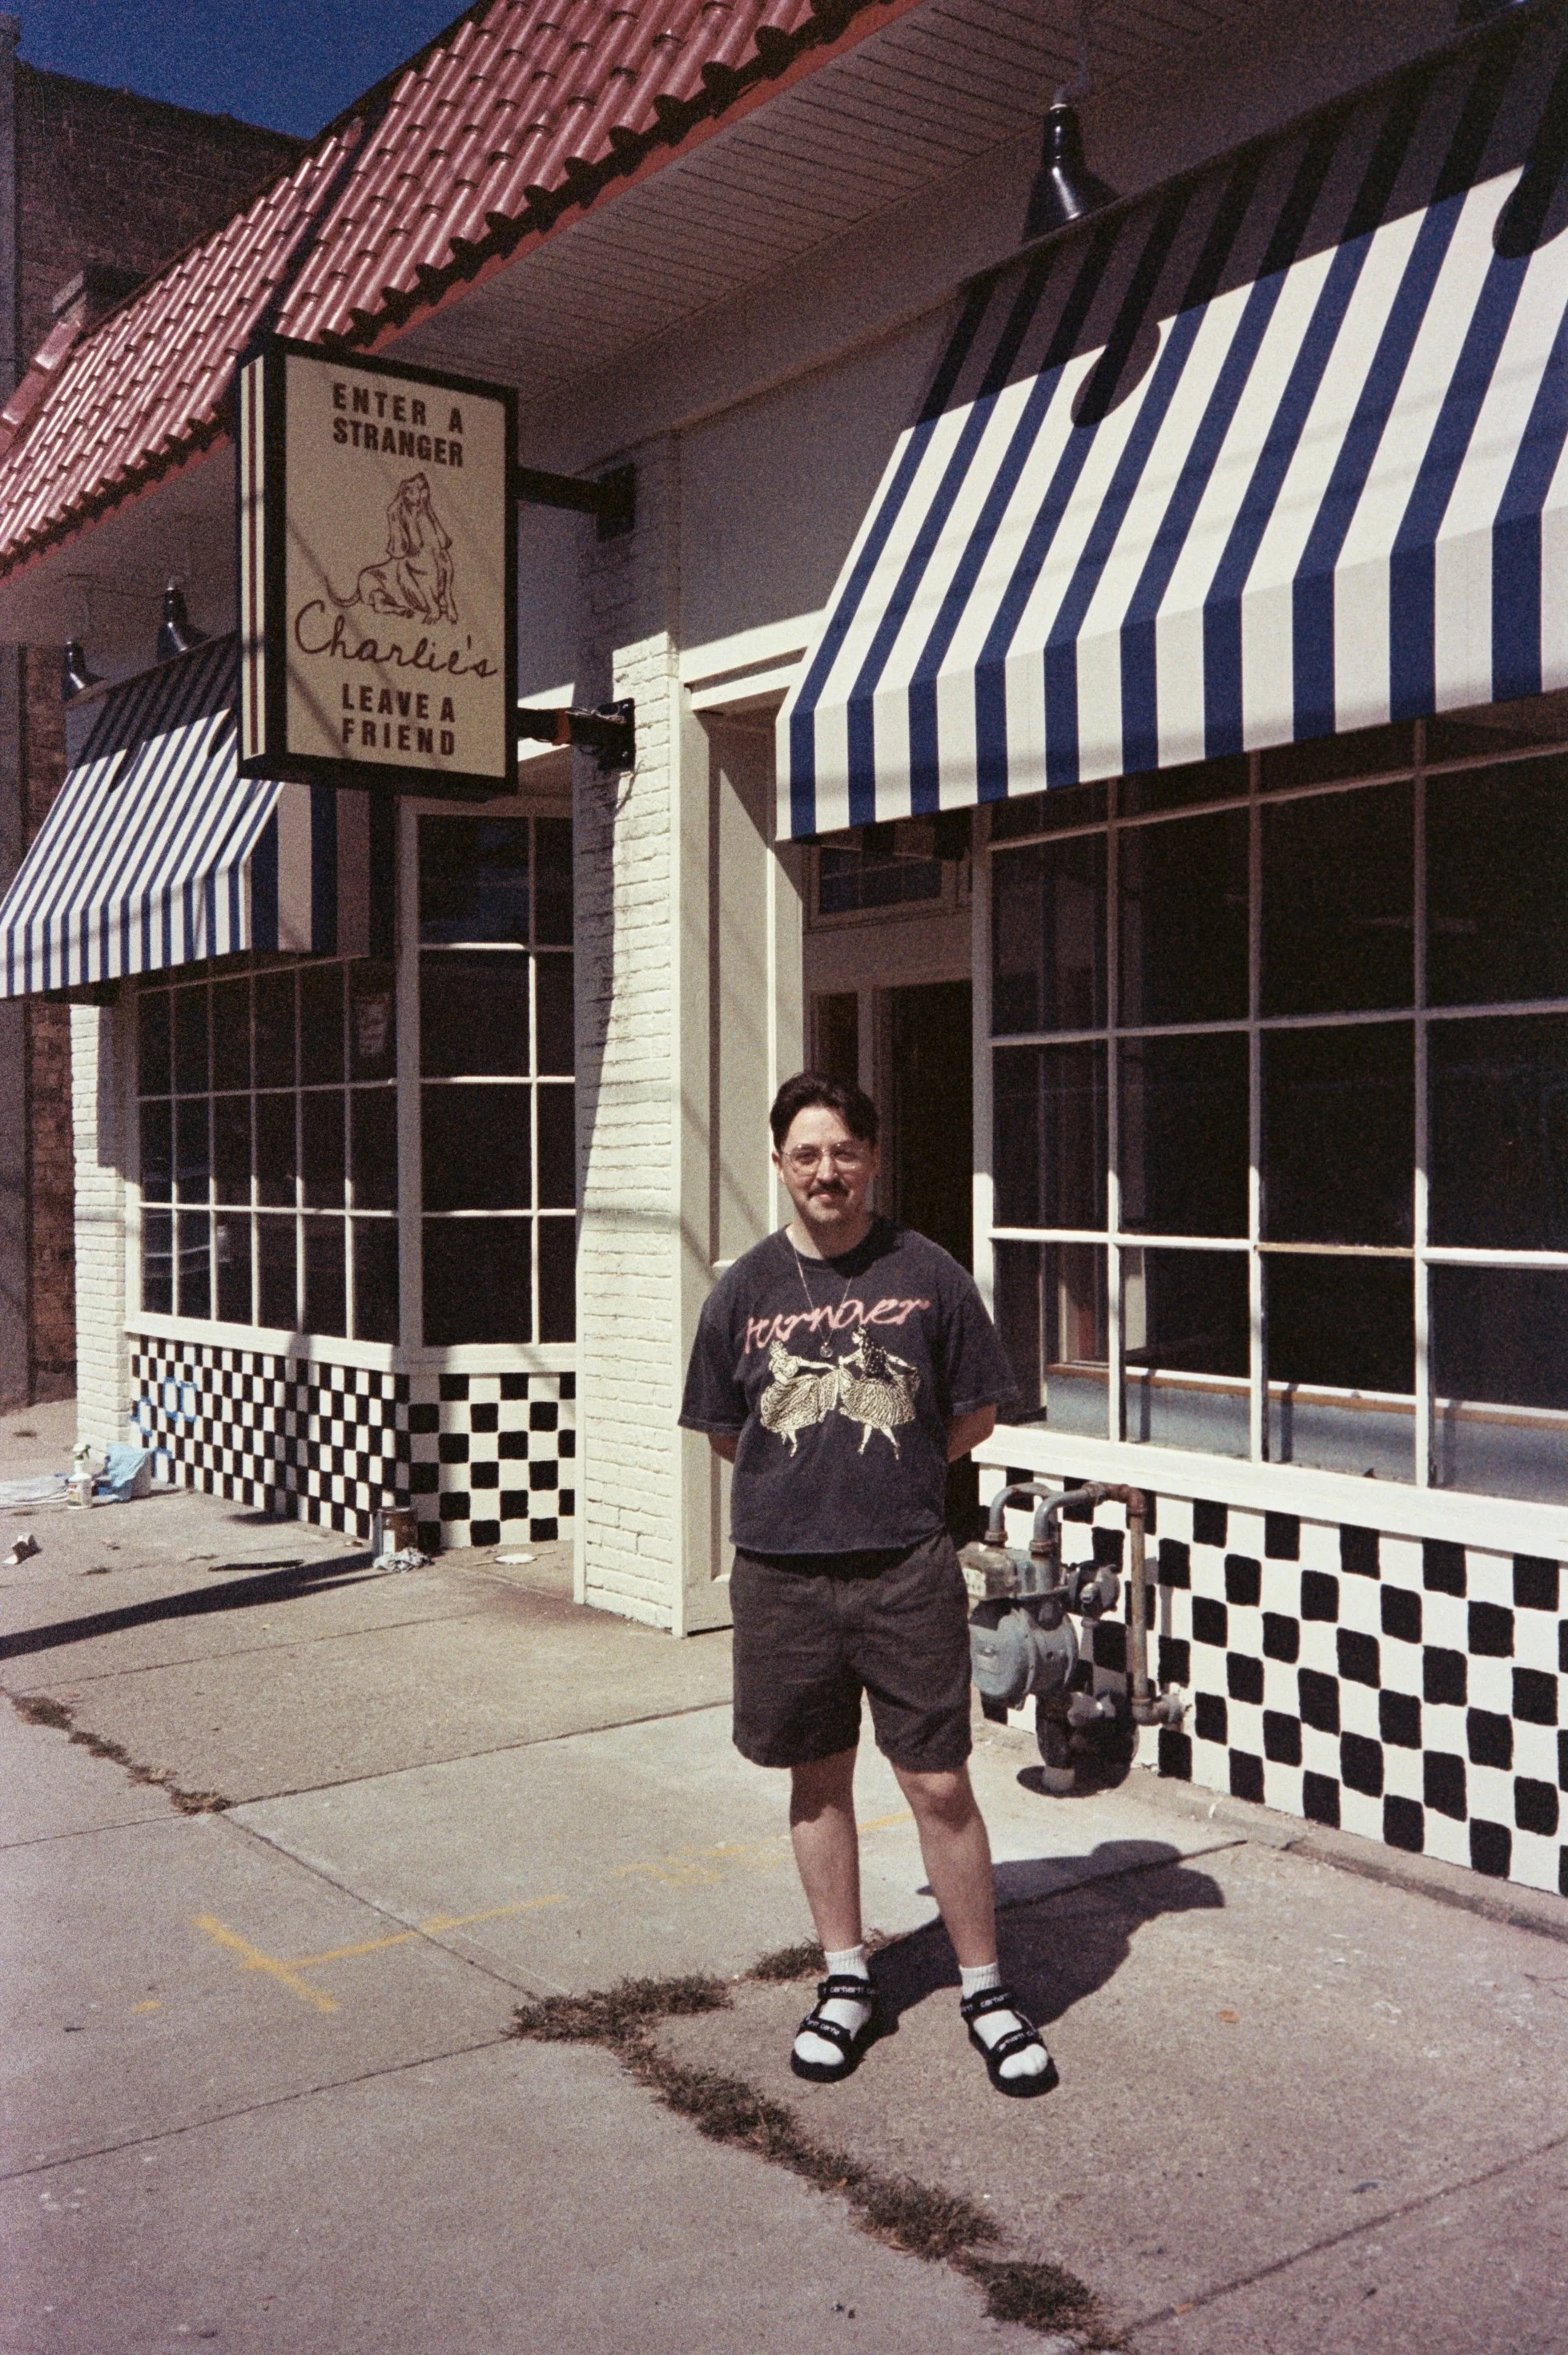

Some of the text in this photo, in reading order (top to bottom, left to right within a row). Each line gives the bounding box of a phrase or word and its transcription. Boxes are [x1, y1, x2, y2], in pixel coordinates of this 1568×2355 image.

[332, 382, 464, 434] ENTER A
[332, 417, 464, 468] STRANGER
[295, 599, 498, 678] Charlie's
[342, 683, 456, 723] LEAVE A
[342, 718, 455, 756] FRIEND
